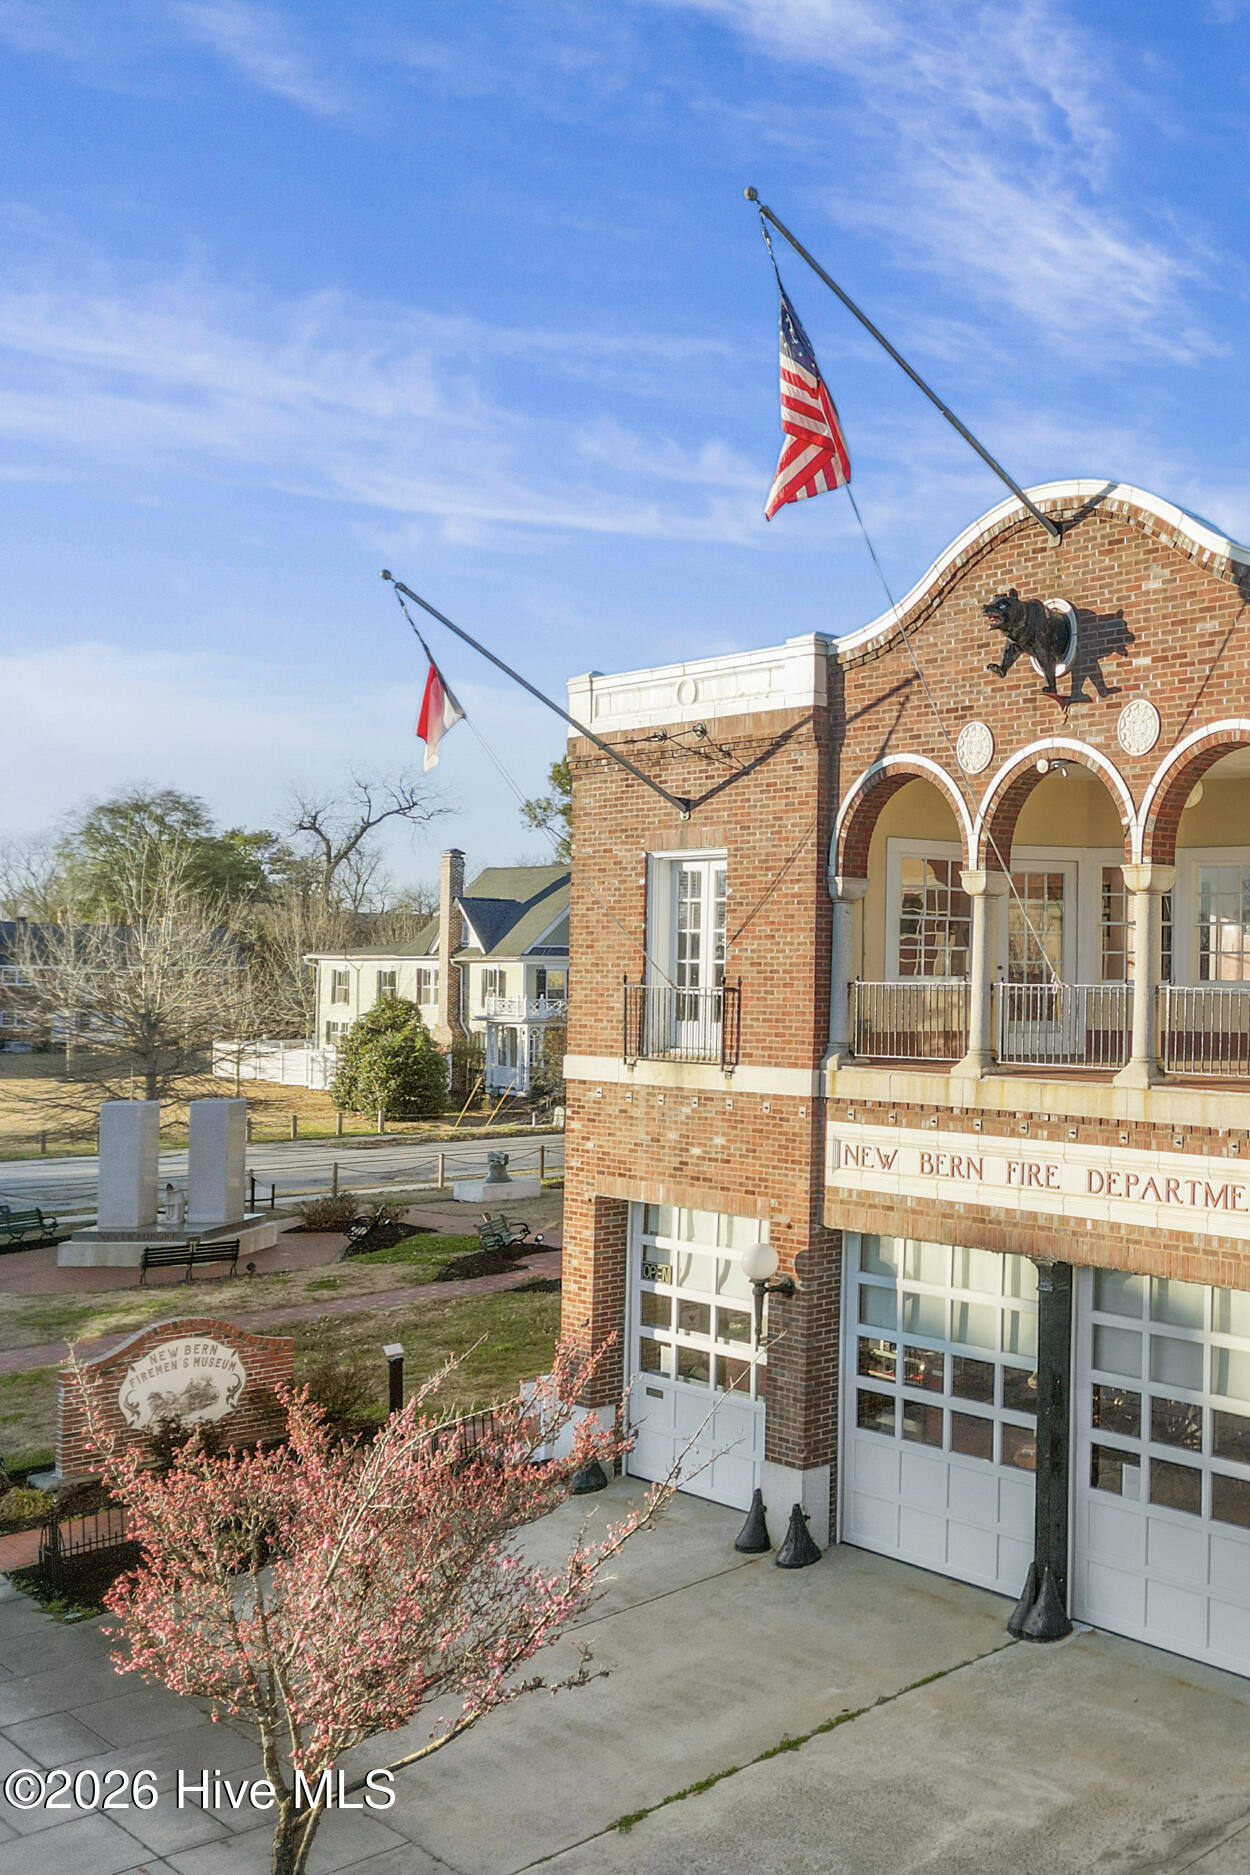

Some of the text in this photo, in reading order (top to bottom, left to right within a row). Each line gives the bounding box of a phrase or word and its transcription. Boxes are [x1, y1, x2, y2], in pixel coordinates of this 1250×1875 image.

[844, 1143, 899, 1170] NEW
[919, 1151, 984, 1181] BERN
[1006, 1160, 1061, 1190] FIRE
[643, 1264, 669, 1282] OPEN
[149, 1344, 219, 1366] NEW BERN
[192, 1357, 237, 1372] MUSEUM
